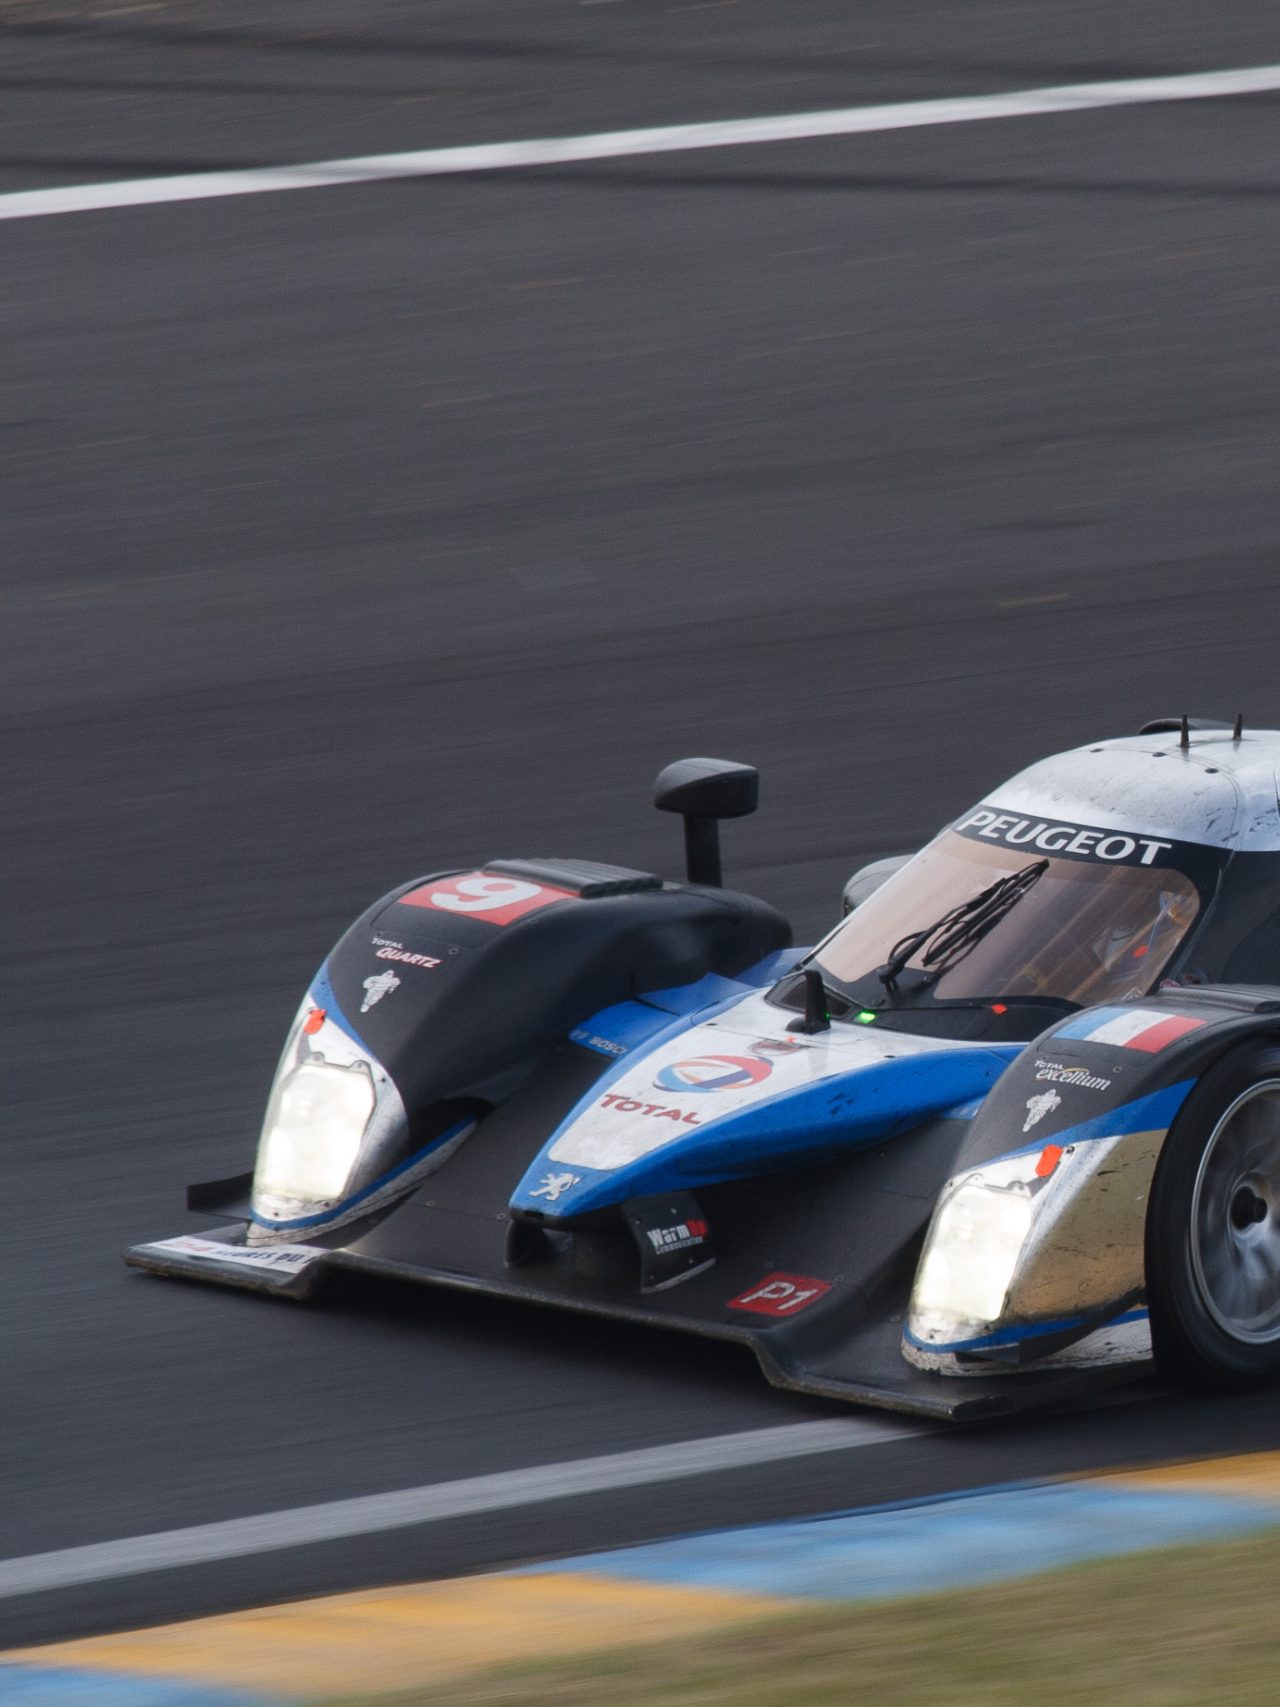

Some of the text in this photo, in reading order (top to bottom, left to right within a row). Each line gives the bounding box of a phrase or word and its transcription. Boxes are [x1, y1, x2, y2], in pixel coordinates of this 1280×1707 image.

[955, 810, 1172, 865] PEUGEOT
[431, 877, 542, 912] 9
[372, 937, 404, 950] TOTAL
[375, 947, 441, 968] QUARTZ
[1034, 1060, 1064, 1071] TOTAL
[1035, 1067, 1112, 1091] excellium
[600, 1093, 702, 1125] TOTAL
[739, 1280, 818, 1310] P1
